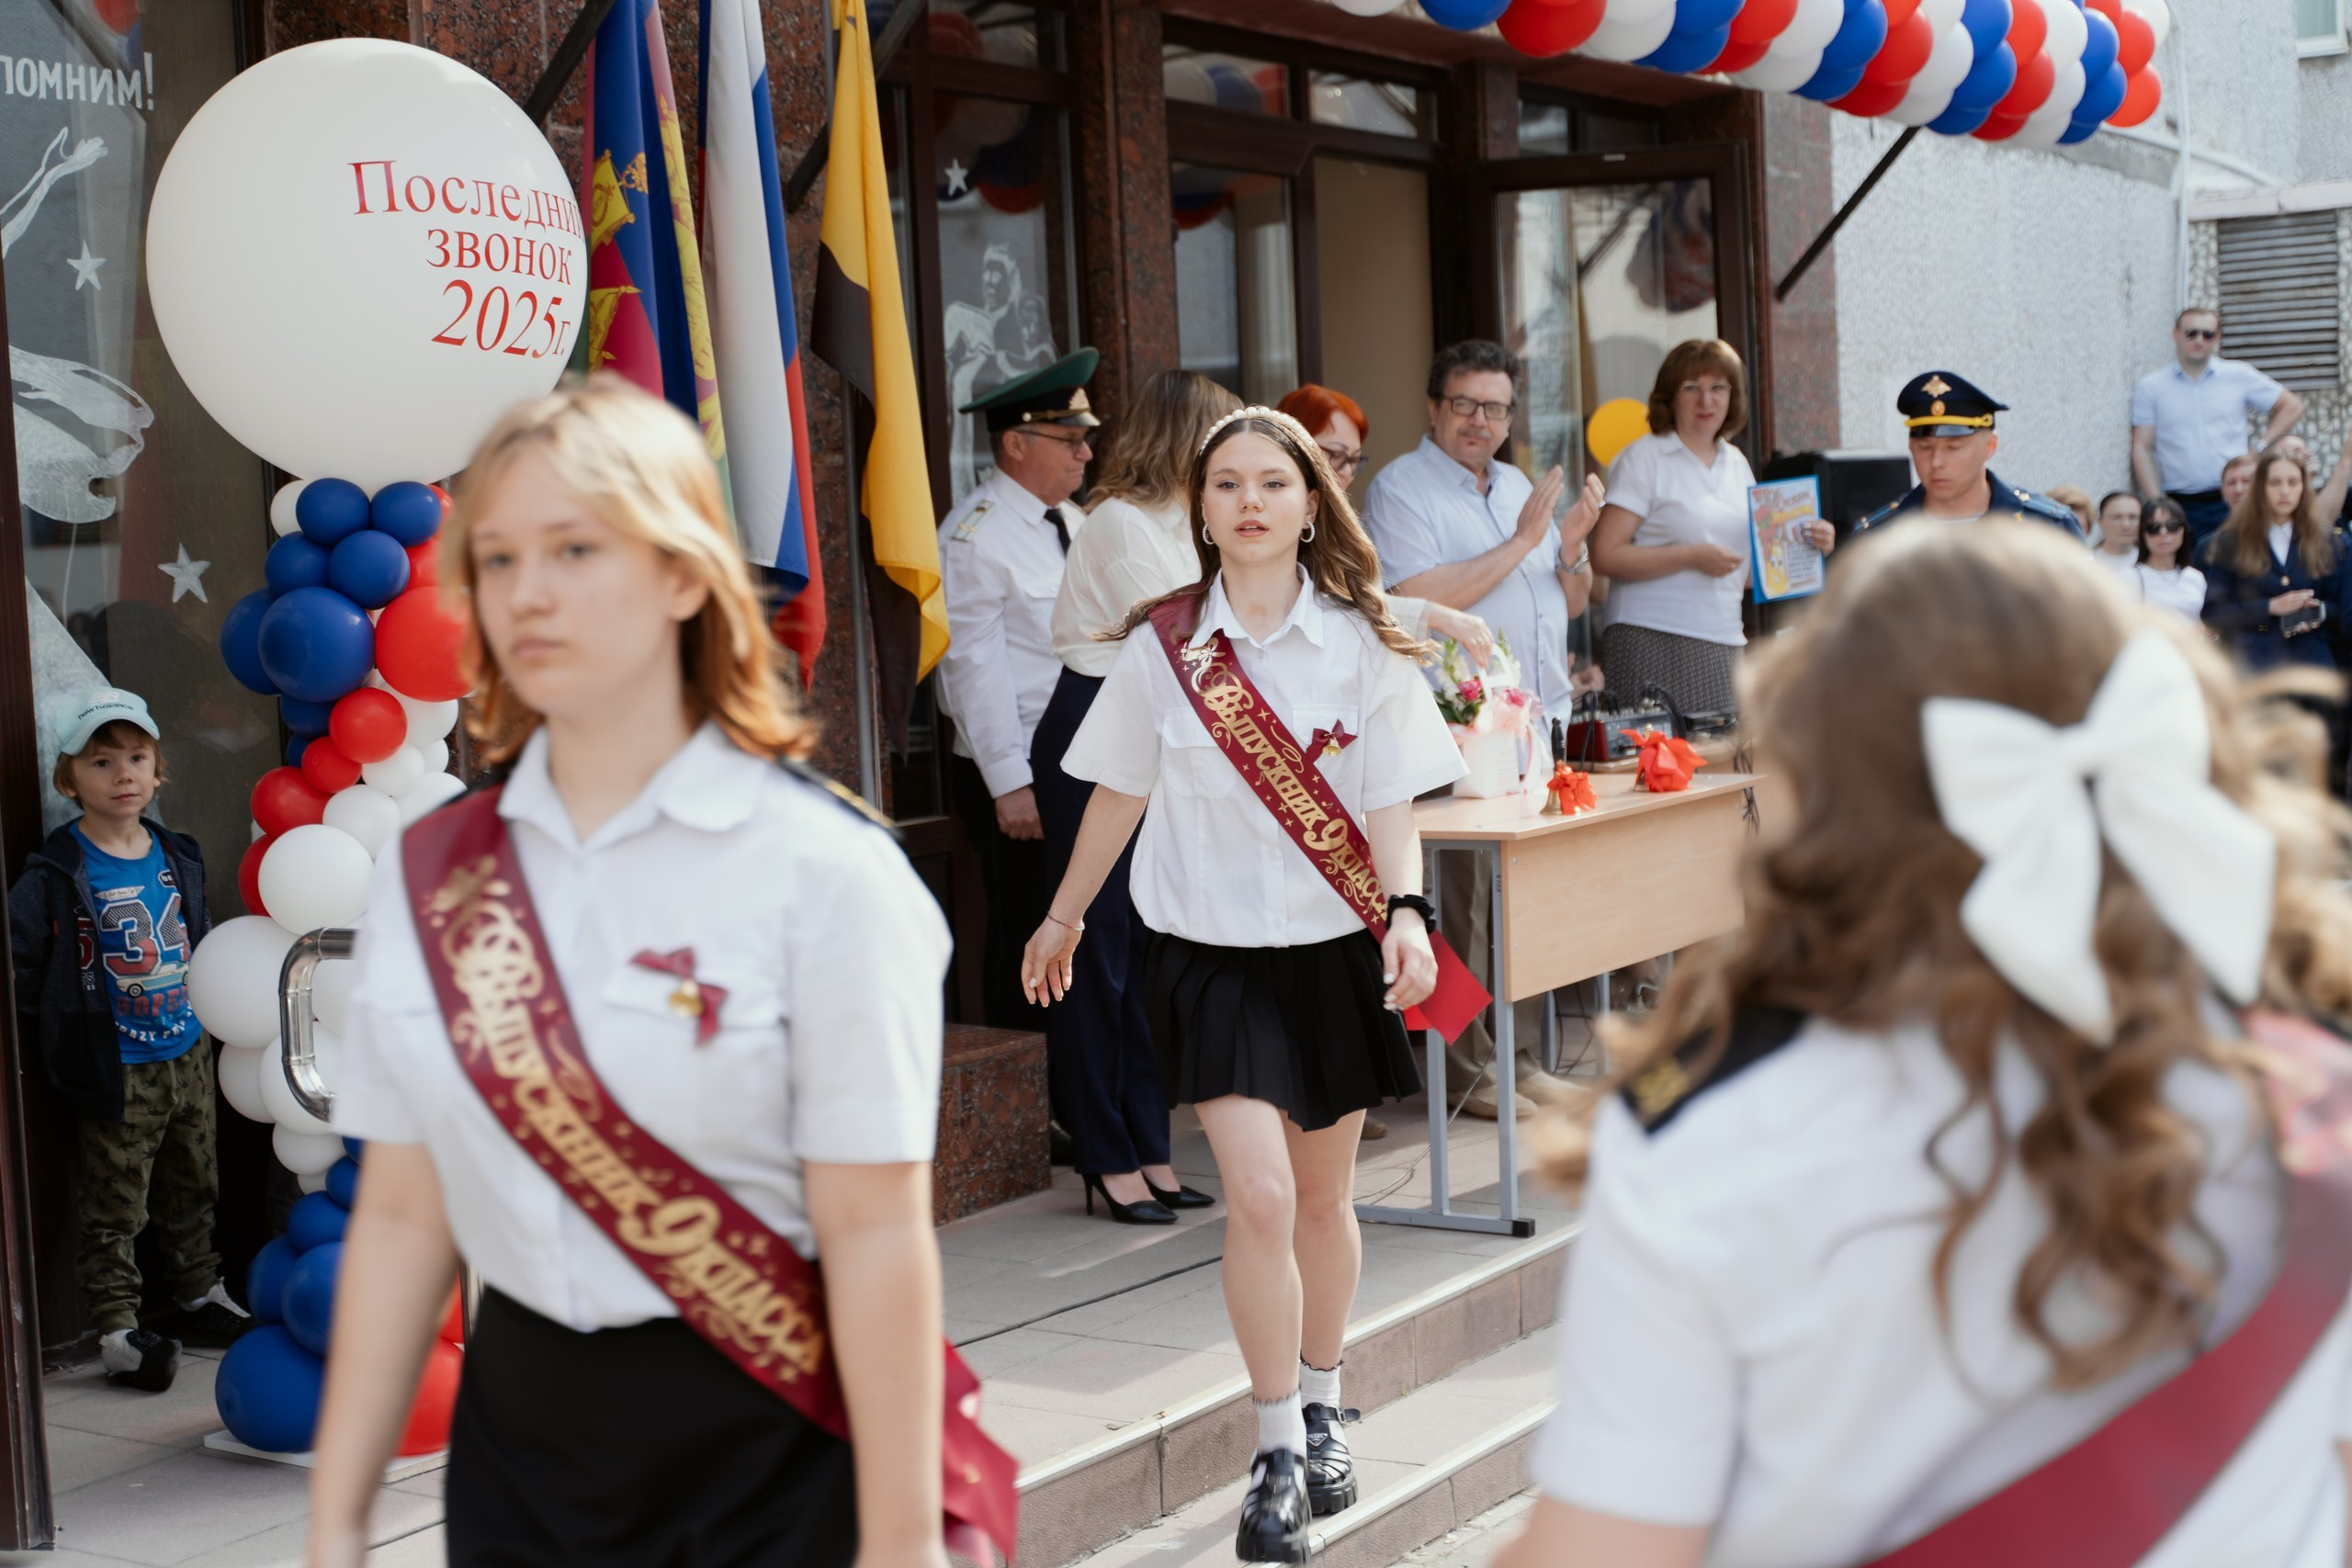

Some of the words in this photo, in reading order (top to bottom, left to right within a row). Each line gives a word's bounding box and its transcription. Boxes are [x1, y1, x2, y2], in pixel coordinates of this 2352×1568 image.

[426, 228, 571, 286] звонок
[431, 279, 571, 359] 2025г.
[77, 707, 94, 720] new
[95, 703, 134, 711] balance
[1303, 818, 1349, 851] 9
[616, 1195, 721, 1256] 9
